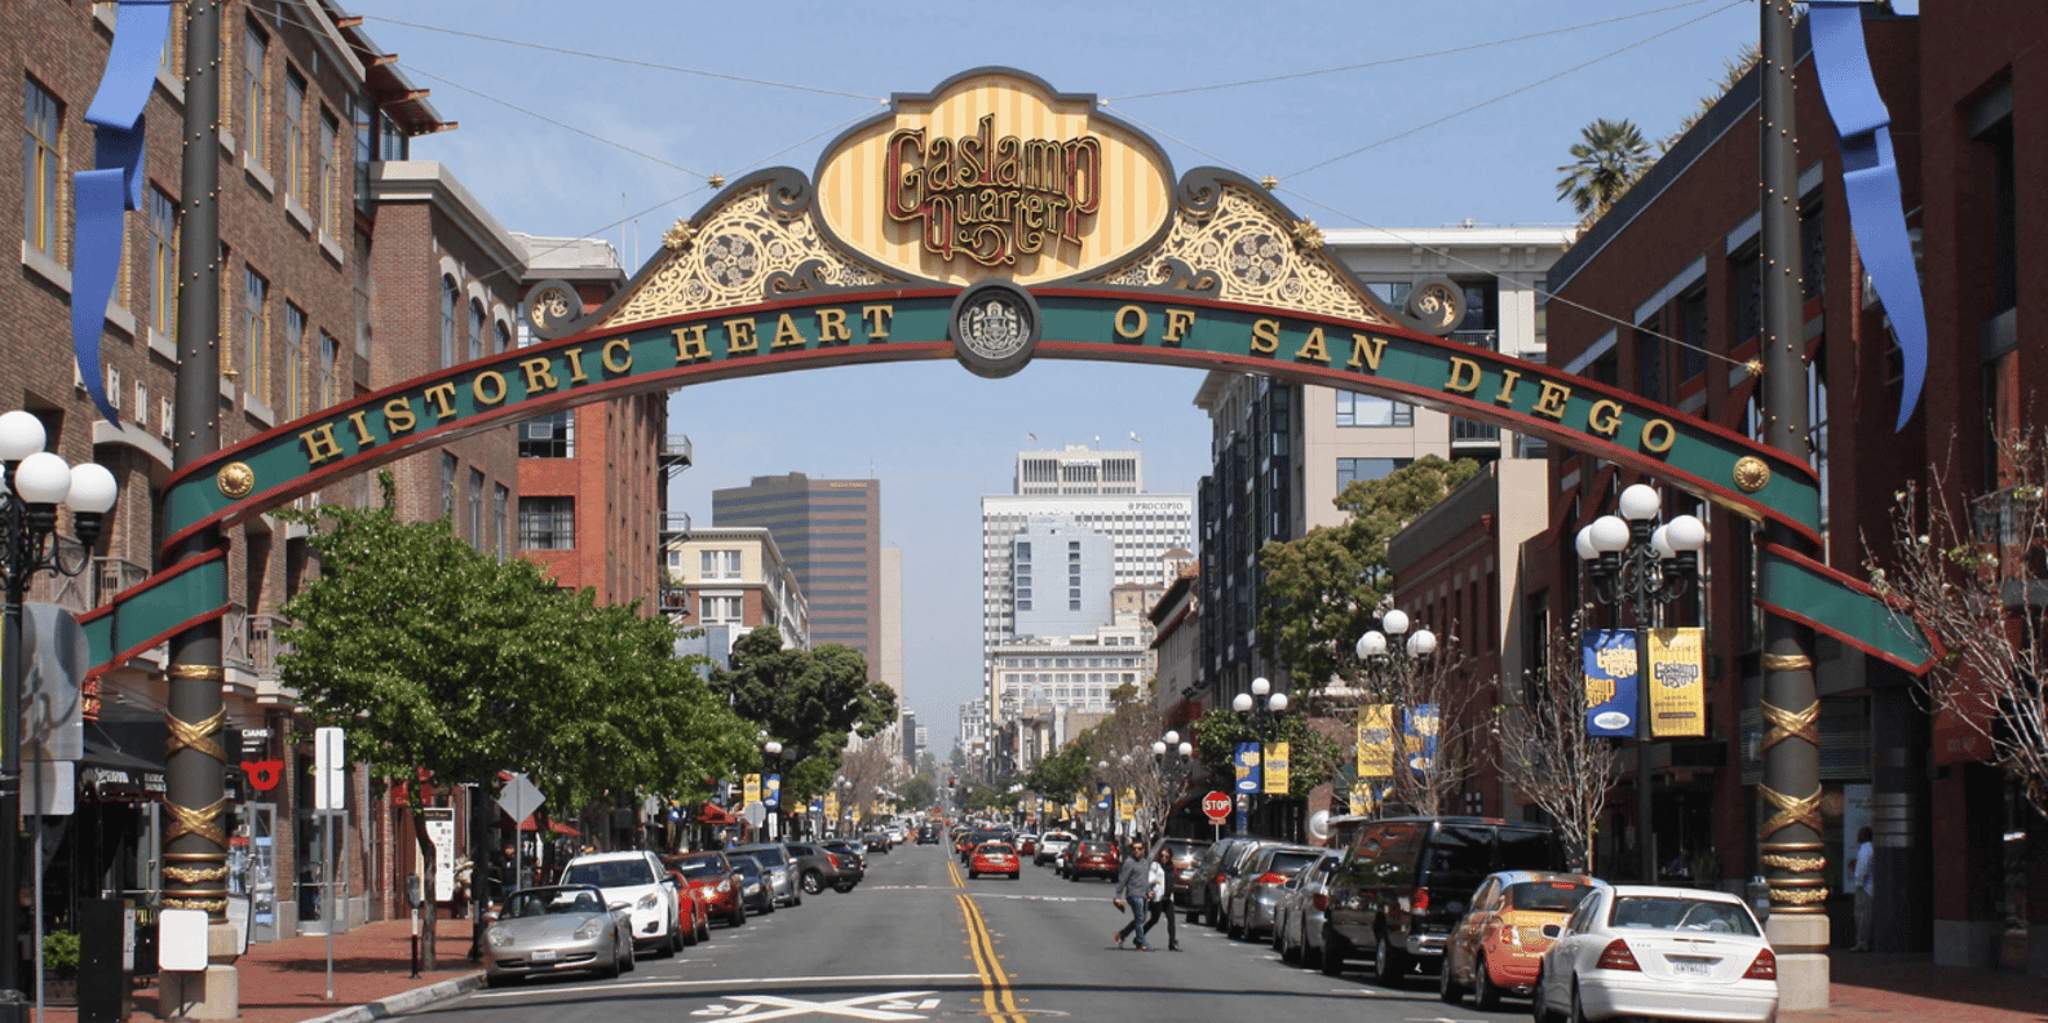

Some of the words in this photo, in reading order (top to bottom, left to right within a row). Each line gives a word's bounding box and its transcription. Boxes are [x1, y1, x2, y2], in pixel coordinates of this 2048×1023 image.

[887, 112, 1102, 246] Gaslamp
[922, 187, 1070, 267] Quarter
[299, 338, 633, 464] HISTORIC
[671, 305, 894, 362] HEART
[1114, 305, 1196, 342] OF
[1250, 318, 1389, 370] SAN
[1444, 356, 1677, 453] DIEGO
[1135, 502, 1184, 510] PROCOPIO
[1205, 800, 1230, 811] STOP
